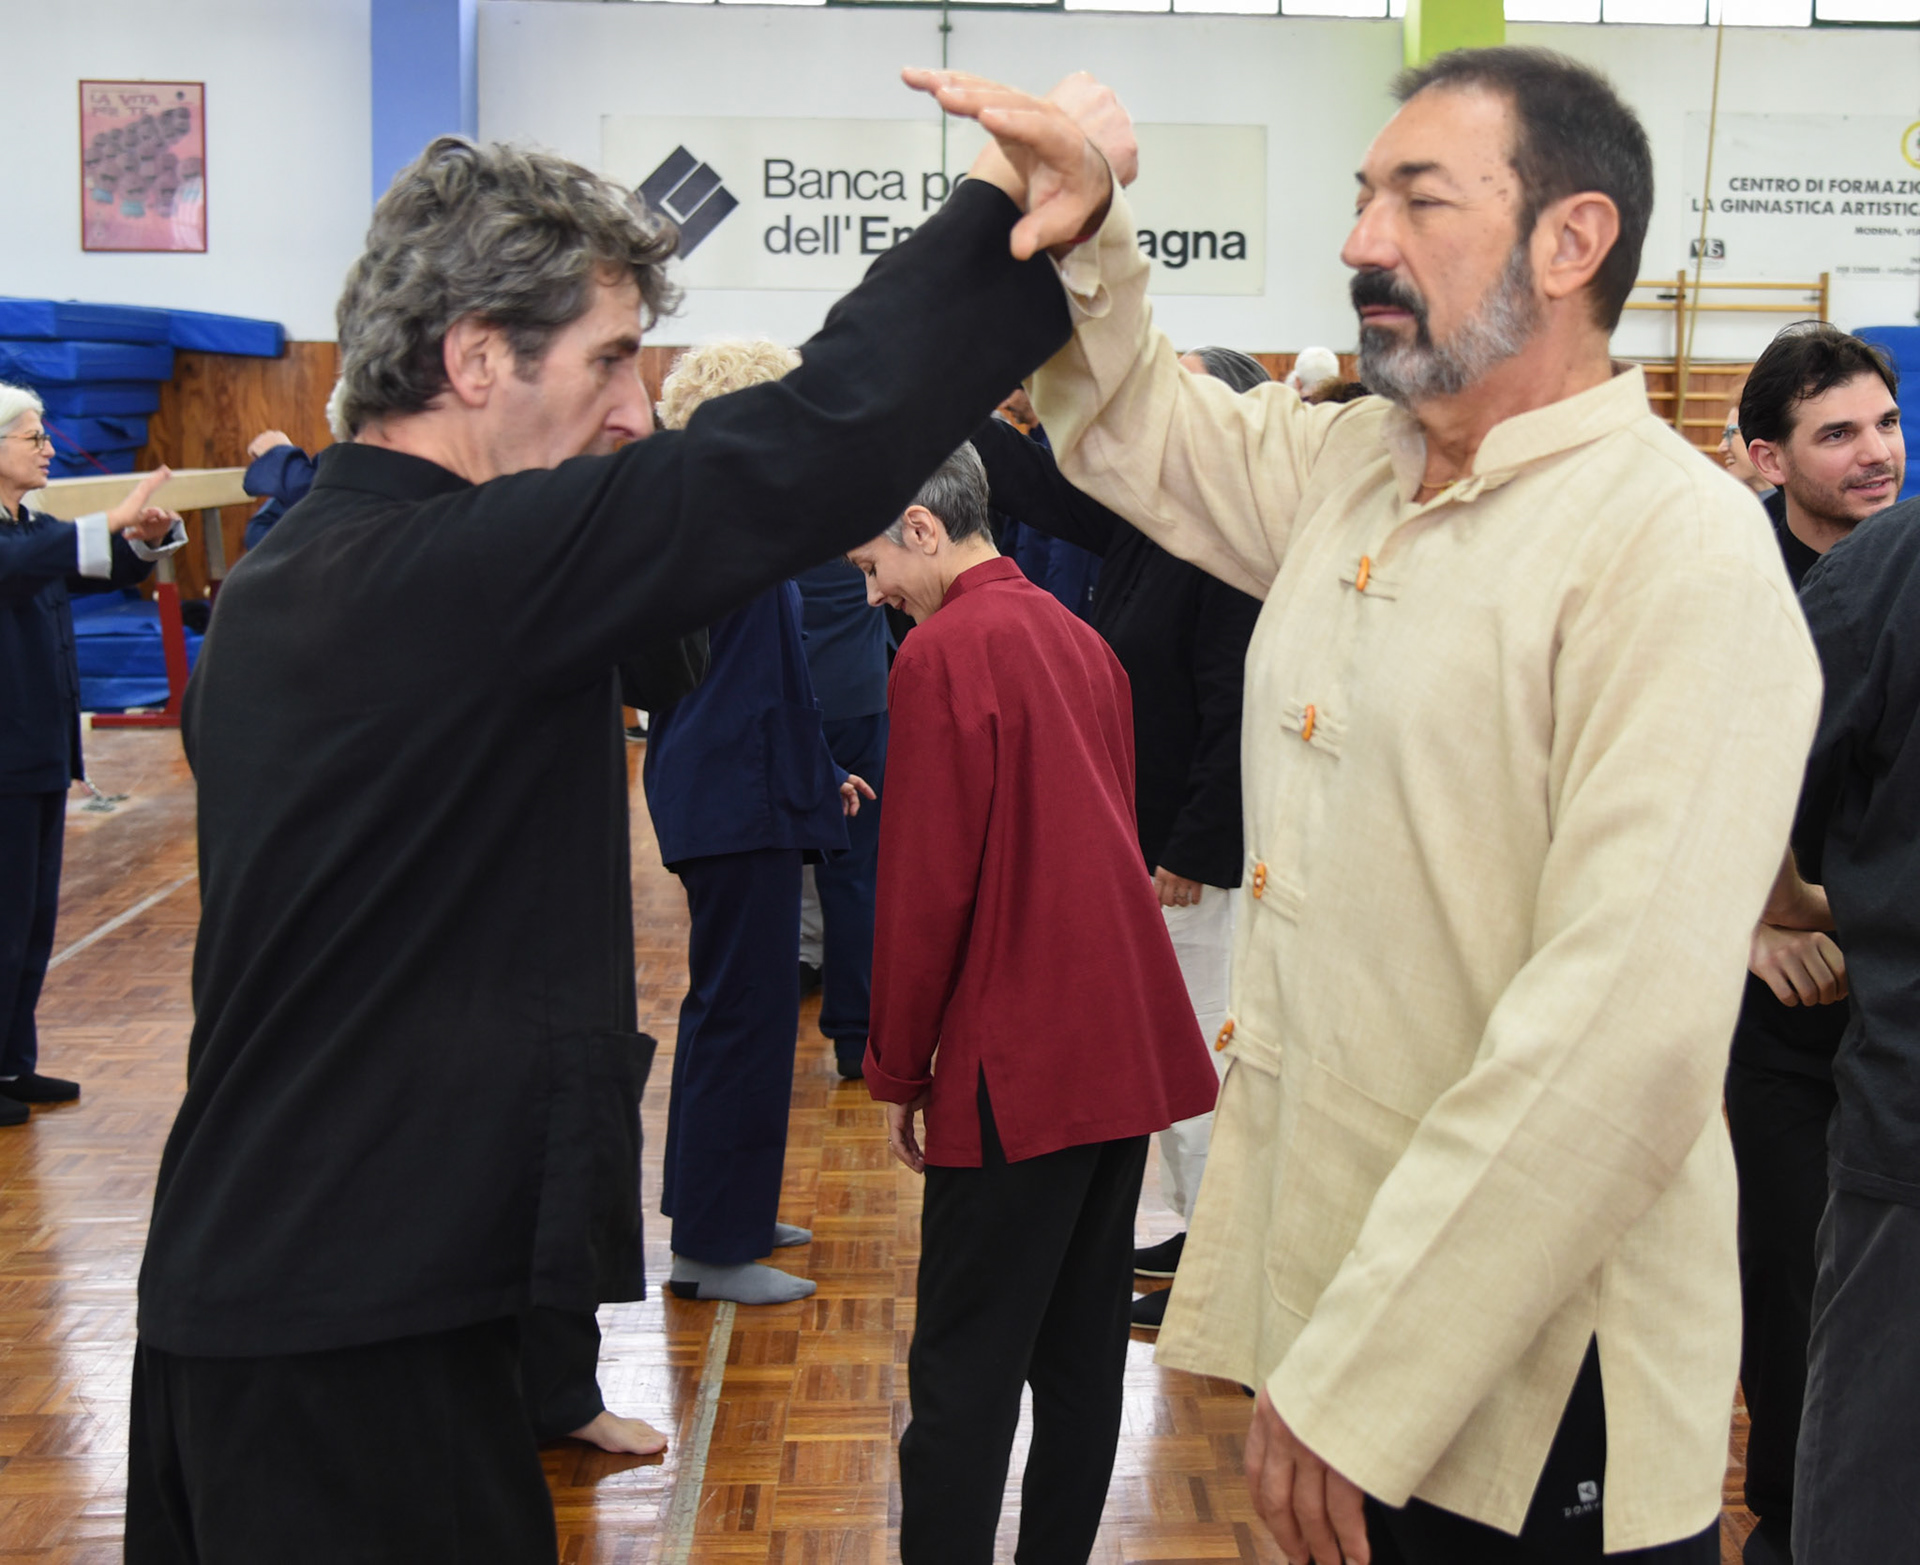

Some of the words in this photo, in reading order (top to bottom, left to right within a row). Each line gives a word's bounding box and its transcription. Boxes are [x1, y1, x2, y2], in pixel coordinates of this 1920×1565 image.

[763, 158, 907, 201] Banca
[1728, 177, 1801, 192] CENTRO
[1805, 178, 1824, 193] DI
[1691, 198, 1715, 212] LA
[1720, 199, 1835, 215] GINNASTICA
[1840, 201, 1920, 216] ARTISTIC
[1136, 229, 1246, 270] agna
